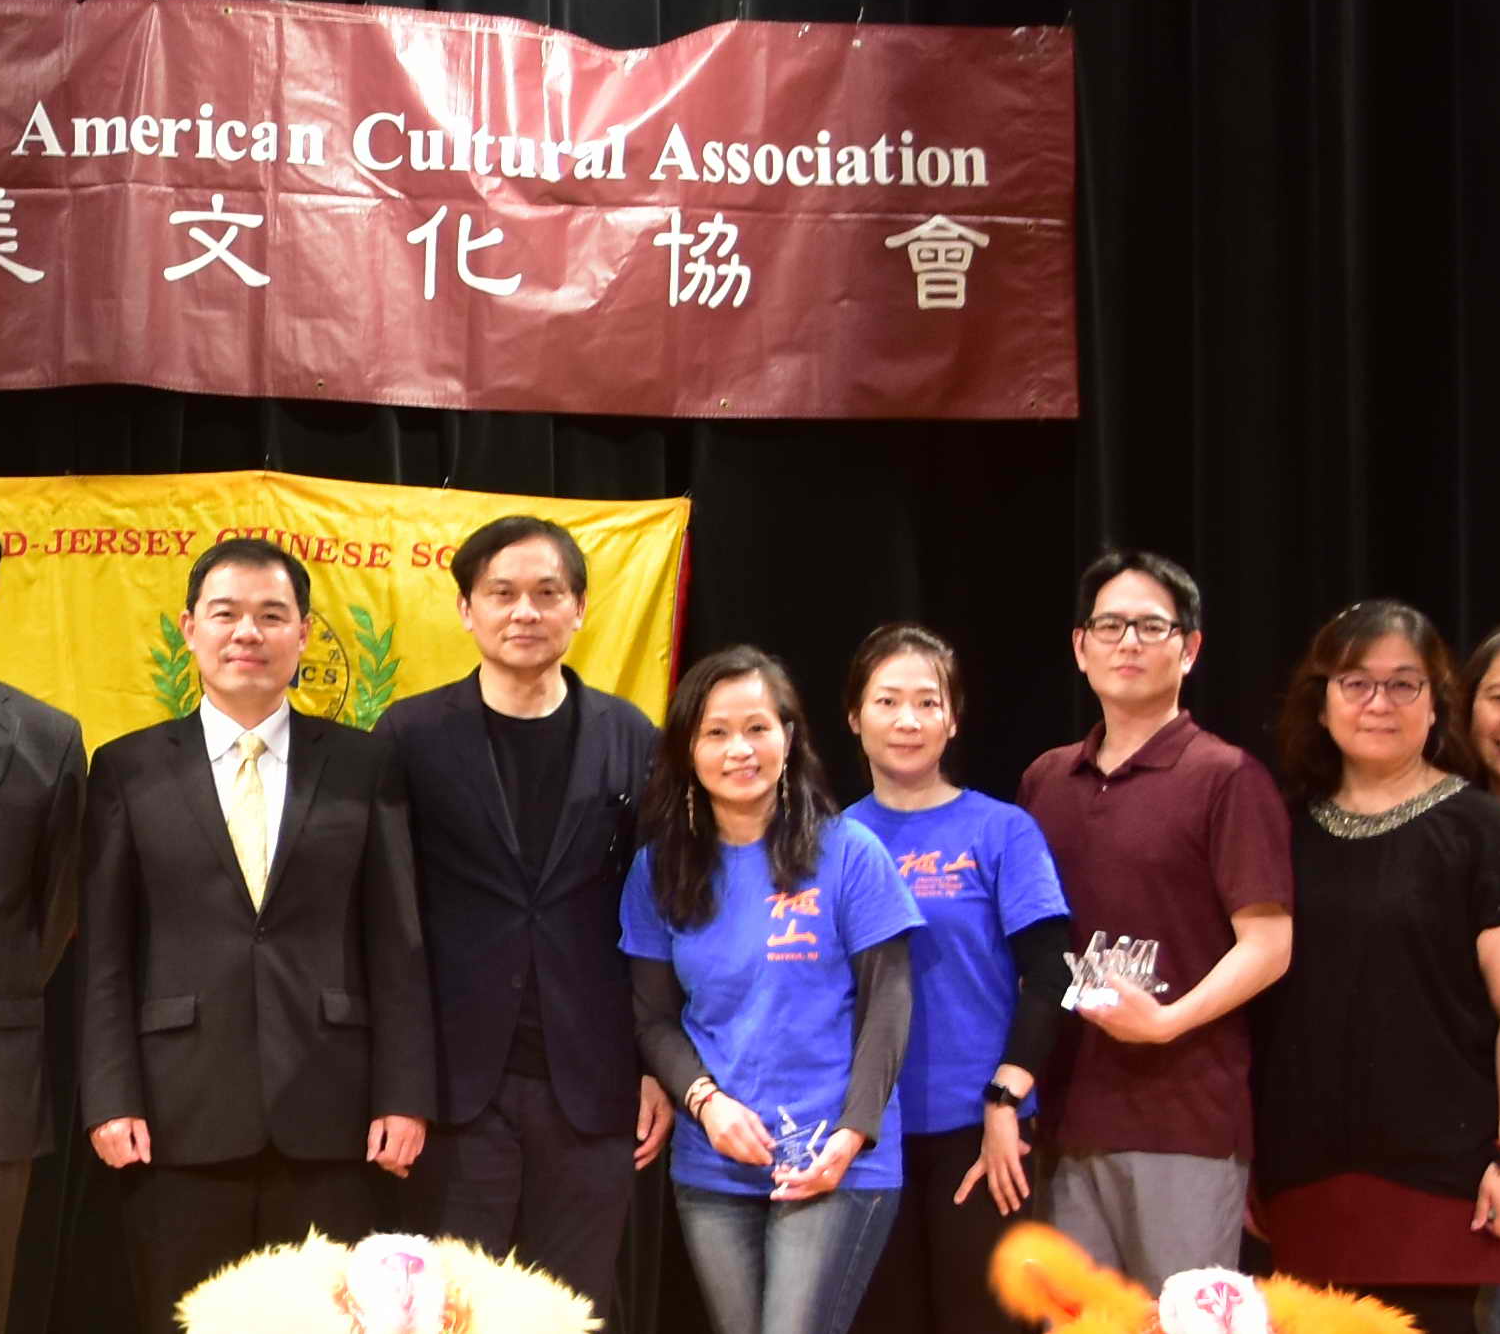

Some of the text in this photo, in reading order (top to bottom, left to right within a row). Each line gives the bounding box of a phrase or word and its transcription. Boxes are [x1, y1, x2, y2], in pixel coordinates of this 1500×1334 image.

[11, 100, 325, 166] American
[351, 112, 628, 183] Cultural
[650, 122, 990, 188] Association
[2, 527, 197, 557] D-JERSEY
